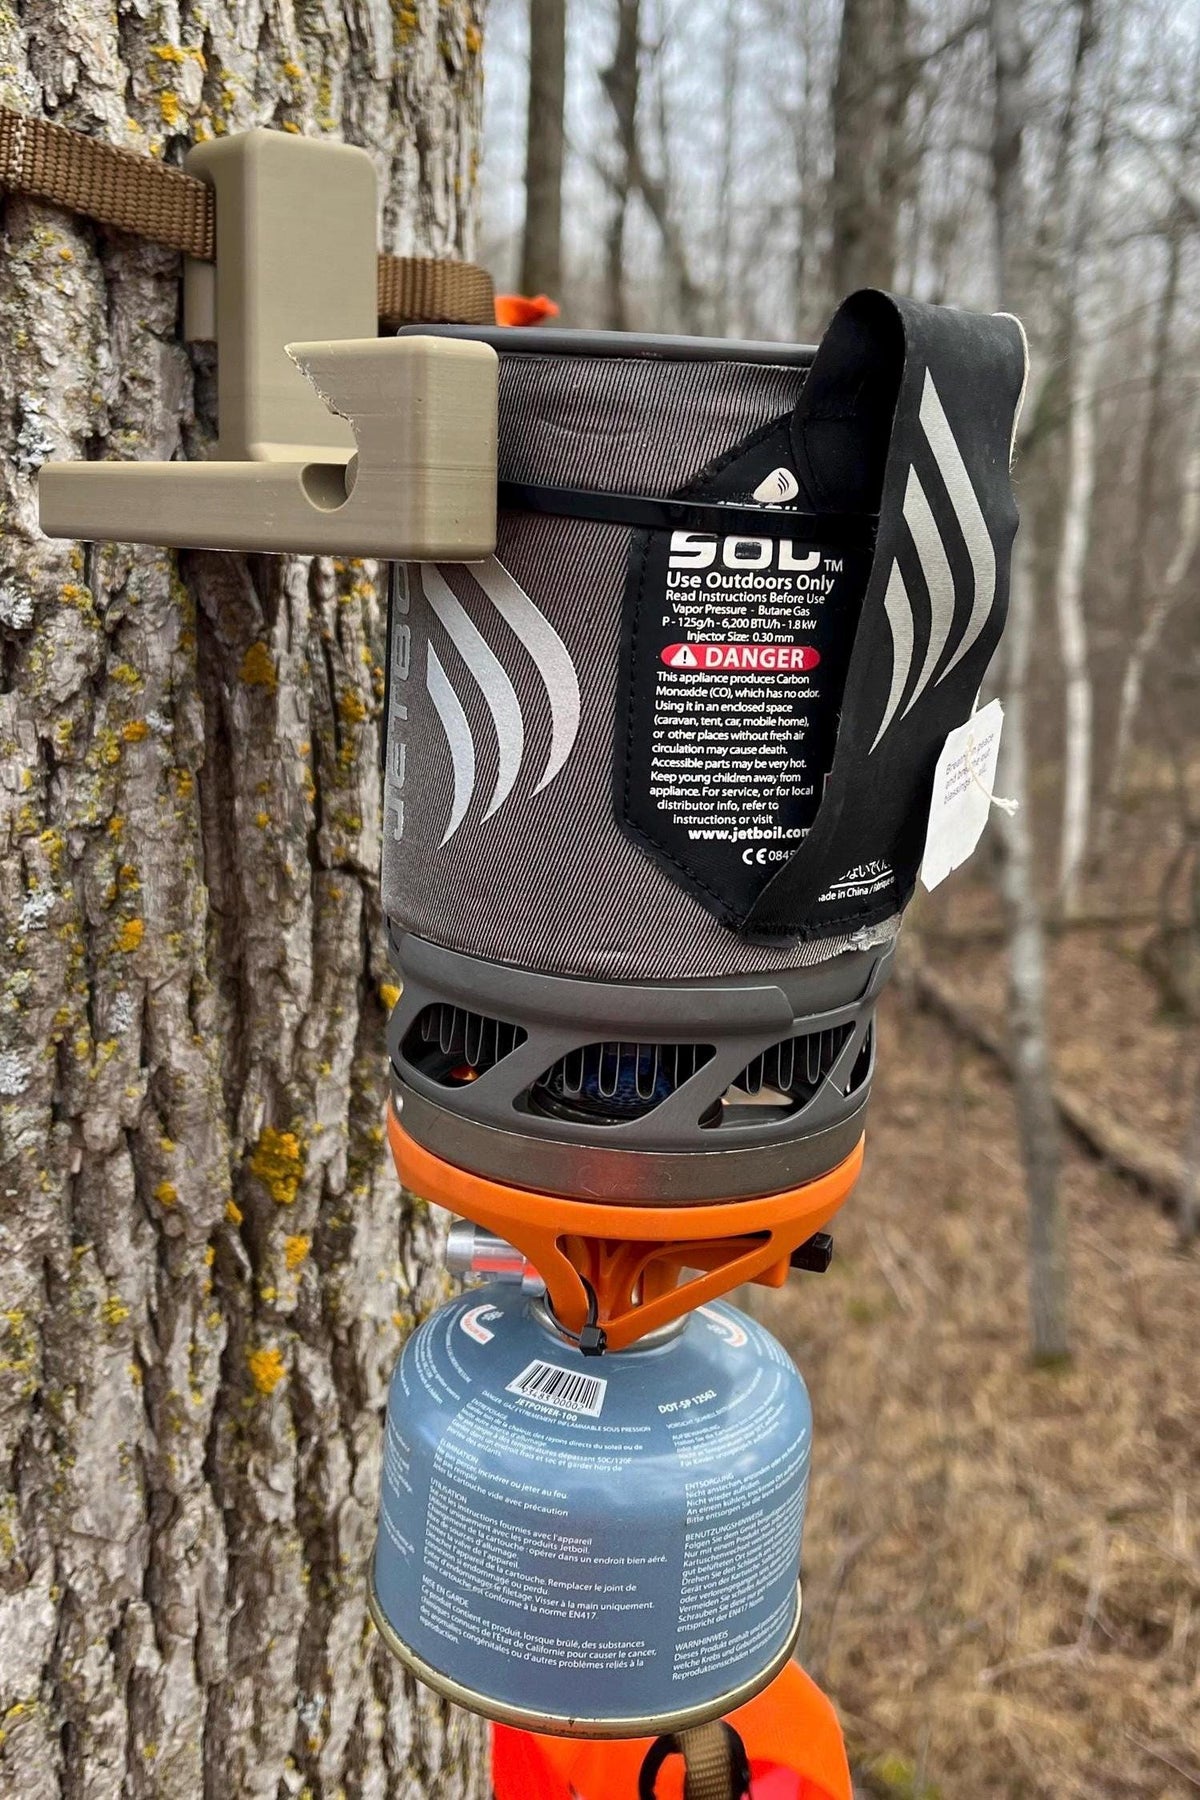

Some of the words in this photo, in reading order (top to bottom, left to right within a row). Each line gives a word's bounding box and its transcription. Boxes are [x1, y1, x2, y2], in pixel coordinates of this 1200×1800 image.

[669, 530, 820, 570] SOL
[667, 572, 702, 588] Use
[706, 573, 792, 590] Outdoors
[796, 575, 835, 594] Only
[666, 590, 696, 601] Read
[699, 590, 766, 602] Instructions
[770, 592, 804, 604] Before
[806, 594, 825, 604] Use
[673, 604, 704, 617] Vapor
[705, 605, 747, 616] Pressure
[758, 606, 792, 616] Butane
[793, 607, 810, 617] Gas
[662, 617, 670, 626] P
[678, 618, 715, 630] 125g/h
[722, 618, 749, 630] 6,200
[750, 618, 781, 629] BTU/h
[788, 620, 801, 630] 1.8
[801, 620, 817, 630] kW
[687, 631, 727, 643] Injector
[728, 632, 750, 642] Size:
[752, 632, 774, 642] 0.30
[775, 634, 794, 643] mm
[706, 647, 804, 668] DANGER
[657, 672, 677, 682] This
[679, 672, 728, 684] appliance
[730, 673, 775, 685] produces
[777, 674, 809, 684] Carbon
[656, 686, 708, 696] Monoxide
[710, 687, 733, 699] (CO),
[735, 688, 764, 698] which
[766, 688, 782, 698] has
[784, 690, 796, 698] no
[798, 688, 820, 698] odor.
[388, 562, 411, 843] JETBO
[655, 700, 684, 713] Using
[686, 701, 693, 711] it
[694, 701, 704, 711] in
[721, 702, 765, 712] enclosed
[766, 704, 793, 715] space
[654, 714, 699, 726] (caravan,
[701, 717, 723, 727] tent,
[725, 718, 741, 727] car,
[743, 716, 776, 726] mobile
[778, 716, 809, 727] home),
[653, 730, 665, 738] or
[668, 729, 696, 740] other
[698, 729, 729, 742] places
[731, 730, 768, 740] without
[770, 730, 792, 740] fresh
[793, 730, 805, 740] air
[652, 743, 704, 754] circulation
[706, 746, 729, 757] may
[729, 746, 757, 754] cause
[758, 744, 788, 754] death.
[651, 757, 703, 768] Accessible
[705, 760, 730, 770] parts
[731, 760, 753, 771] may
[754, 759, 767, 768] be
[768, 760, 789, 771] very
[790, 758, 807, 768] hot.
[651, 771, 677, 784] Keep
[678, 774, 711, 785] young
[712, 772, 752, 783] children
[780, 772, 801, 782] from
[650, 786, 701, 798] appliance.
[702, 786, 720, 796] For
[722, 787, 760, 798] service,
[763, 788, 774, 796] or
[776, 786, 790, 796] for
[792, 785, 814, 796] local
[657, 800, 715, 810] distributor
[717, 800, 740, 812] info,
[742, 800, 767, 810] refer
[768, 802, 779, 810] to
[673, 814, 736, 824] instructions
[738, 816, 750, 824] or
[752, 814, 773, 824] visit
[838, 890, 845, 899] in
[847, 887, 868, 897] China
[658, 1399, 692, 1414] DOT-SP
[692, 1390, 717, 1405] 12562
[515, 1398, 577, 1421] JETPOWER-100
[510, 1481, 520, 1489] ou
[521, 1483, 540, 1493] jeter
[505, 1497, 522, 1507] avec
[524, 1502, 568, 1516] précaution
[523, 1538, 558, 1550] produits
[533, 1531, 551, 1540] avec
[553, 1534, 592, 1546] l'appareil
[558, 1553, 578, 1562] dans
[511, 1581, 522, 1589] ou
[548, 1578, 592, 1591] Remplacer
[603, 1584, 623, 1593] joint
[535, 1595, 559, 1606] Visser
[568, 1601, 575, 1609] la
[530, 1604, 537, 1612] la
[539, 1608, 567, 1617] norme
[523, 1632, 555, 1645] lorsque
[582, 1640, 596, 1649] des
[598, 1641, 645, 1649] substances
[526, 1642, 565, 1657] Californie
[567, 1650, 587, 1659] pour
[589, 1651, 616, 1659] causer
[619, 1650, 626, 1659] le
[524, 1652, 557, 1666] d'autres
[558, 1660, 604, 1669] problèmes
[637, 1659, 644, 1667] la
